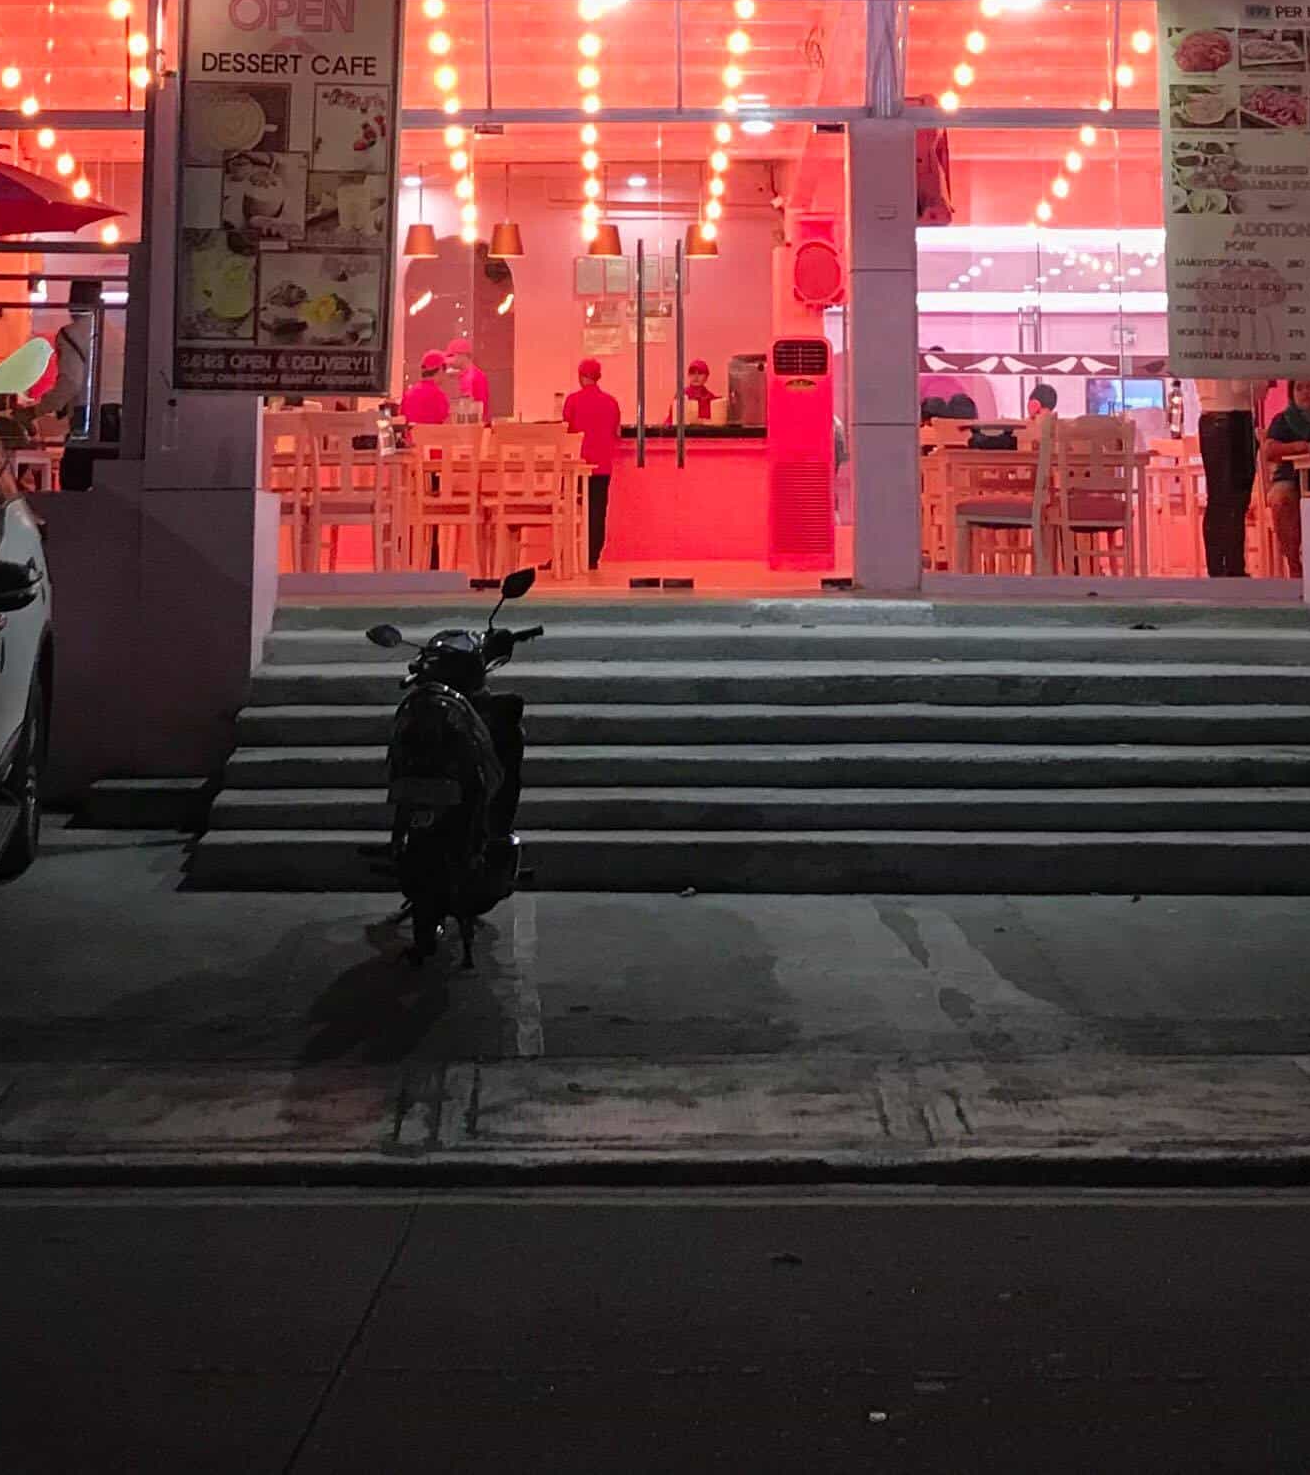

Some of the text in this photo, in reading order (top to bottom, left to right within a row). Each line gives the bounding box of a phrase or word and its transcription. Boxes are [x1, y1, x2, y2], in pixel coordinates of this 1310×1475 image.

[1275, 5, 1302, 19] PER
[201, 52, 377, 77] DESSERT CAFE
[229, 354, 272, 370] OPEN
